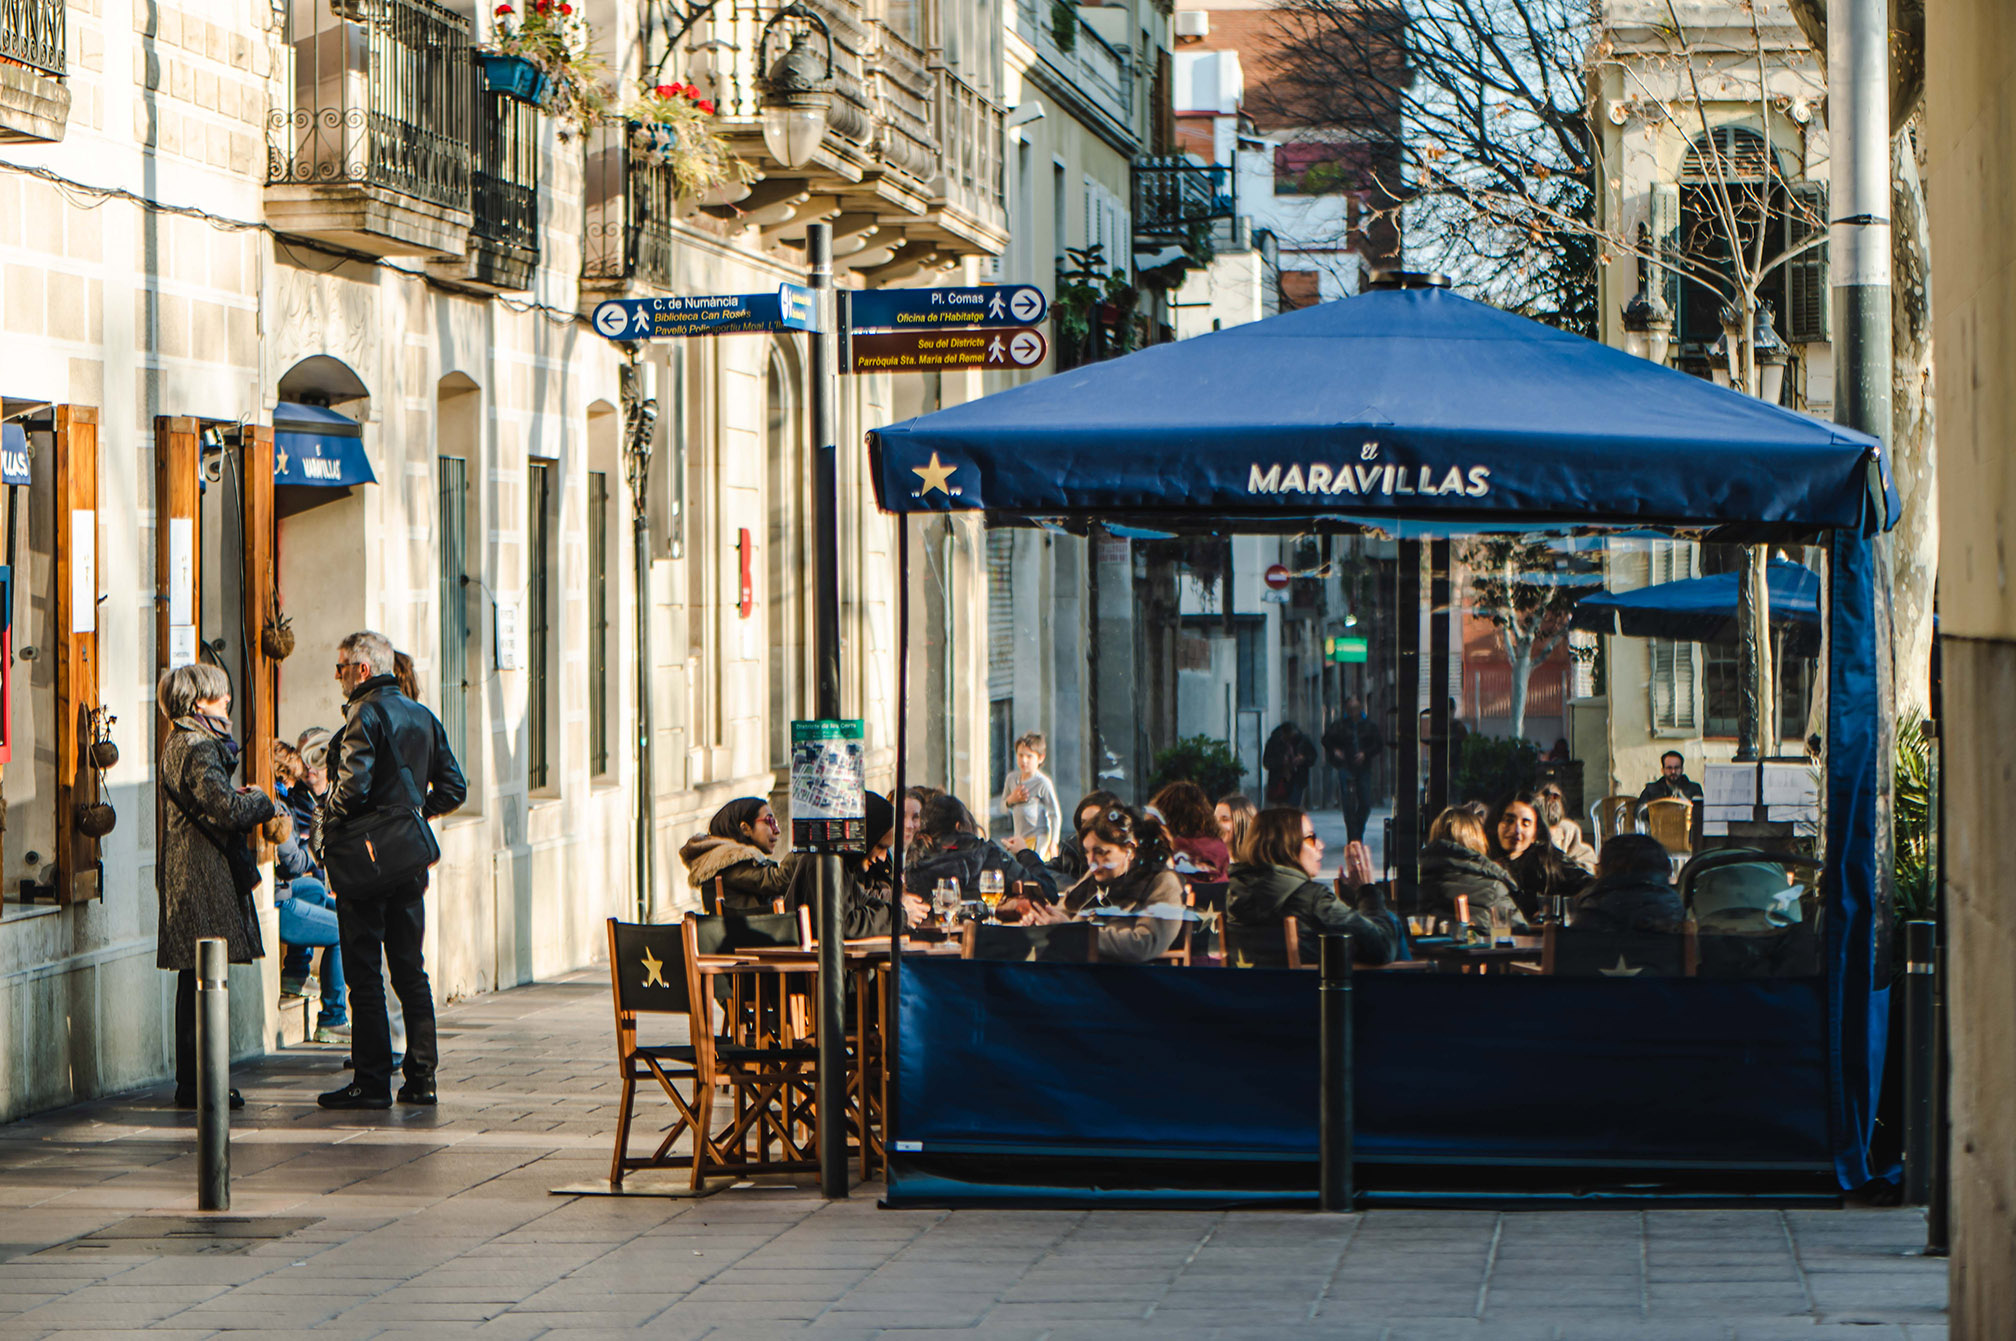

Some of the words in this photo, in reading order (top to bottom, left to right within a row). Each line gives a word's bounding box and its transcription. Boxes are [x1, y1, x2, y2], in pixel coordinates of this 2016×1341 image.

[653, 299, 666, 311] C.
[668, 298, 682, 310] de
[685, 295, 739, 309] Numància
[931, 292, 945, 305] Pl.
[948, 292, 985, 305] Comas
[654, 312, 699, 323] Biblioteca
[701, 310, 720, 320] Can
[722, 308, 752, 320] Rosés
[897, 312, 926, 323] Oficina
[927, 312, 939, 322] de
[940, 311, 985, 323] l'Habitatge
[655, 324, 688, 336] Pavelló
[918, 339, 934, 349] Seu
[936, 338, 949, 348] del
[950, 337, 985, 348] Districte
[858, 355, 899, 367] Parròquia
[900, 354, 917, 365] Sta.
[919, 353, 943, 364] Maria
[944, 353, 957, 363] del
[958, 352, 985, 363] Remei
[1360, 442, 1379, 460] El
[1248, 464, 1491, 497] MARAVILLAS
